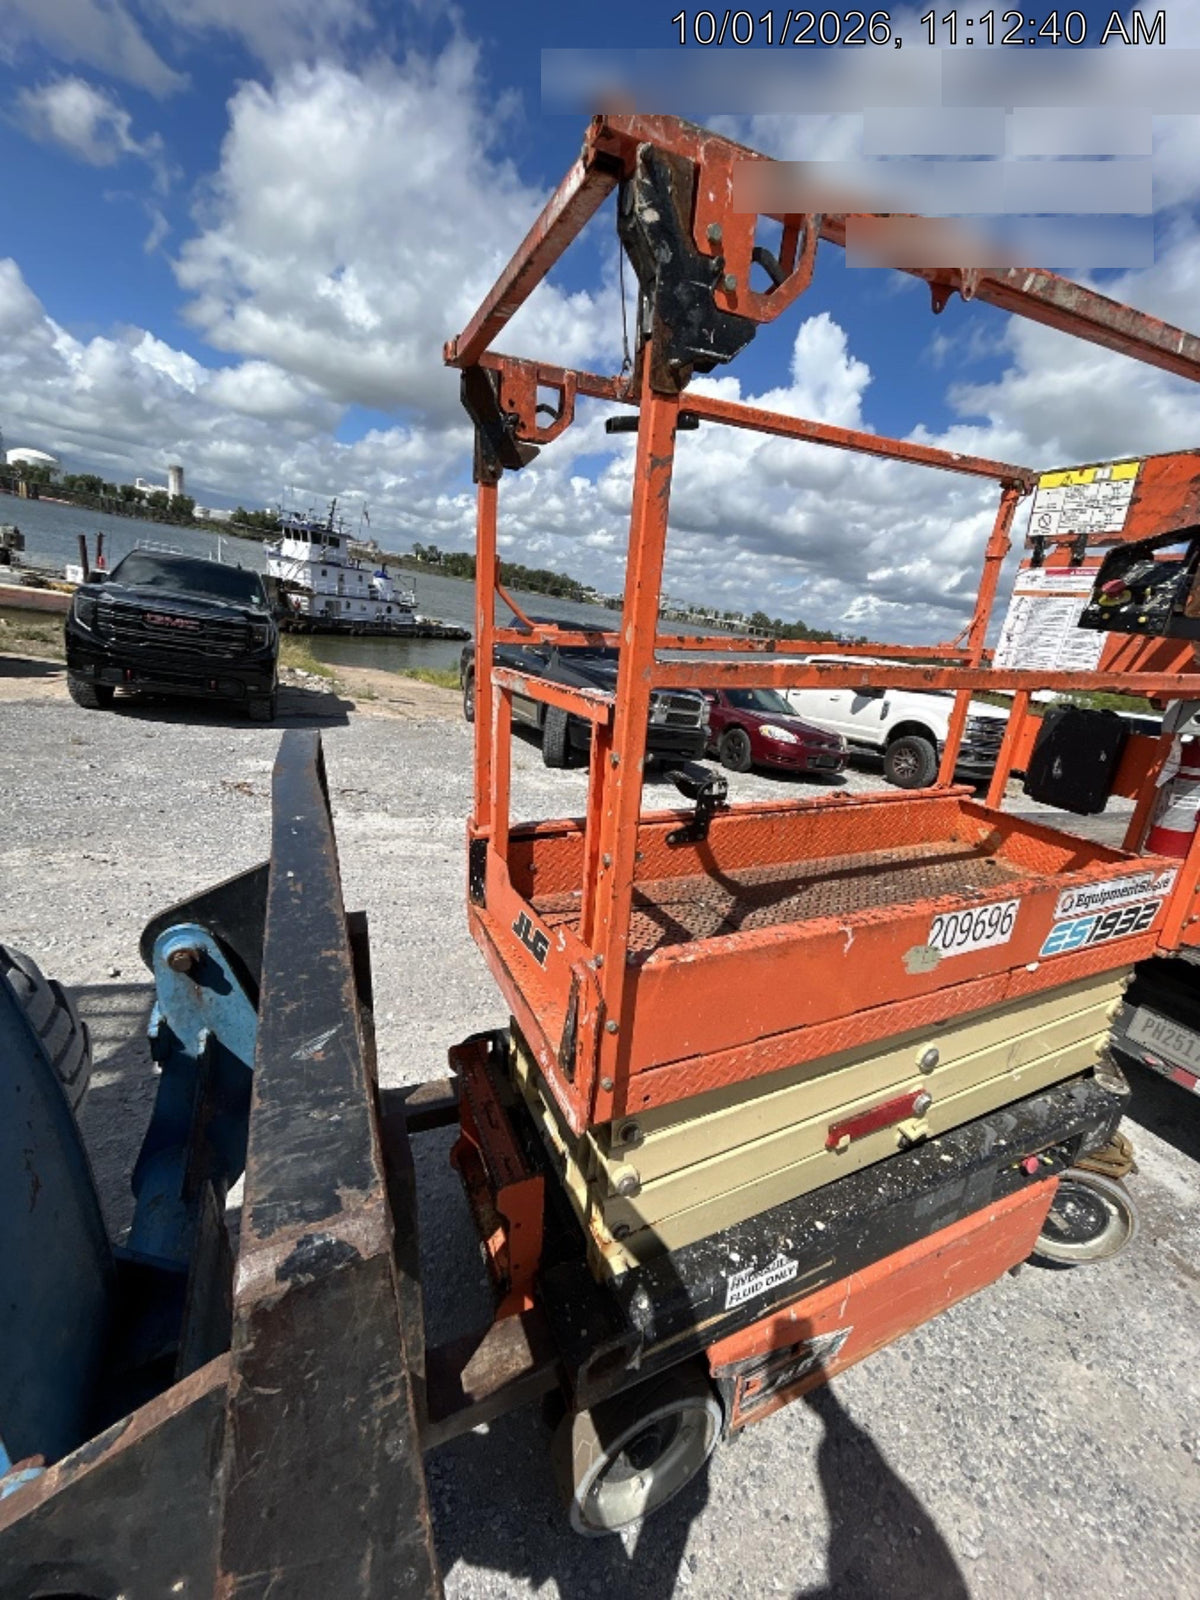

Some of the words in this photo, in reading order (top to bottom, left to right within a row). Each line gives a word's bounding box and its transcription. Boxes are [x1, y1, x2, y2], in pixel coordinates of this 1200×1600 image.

[511, 911, 550, 966] JLG
[929, 902, 1016, 949] 209696
[1041, 901, 1161, 955] ES1932
[1141, 1017, 1200, 1062] PH251
[729, 1281, 764, 1305] FLUID
[765, 1264, 797, 1287] ONLY
